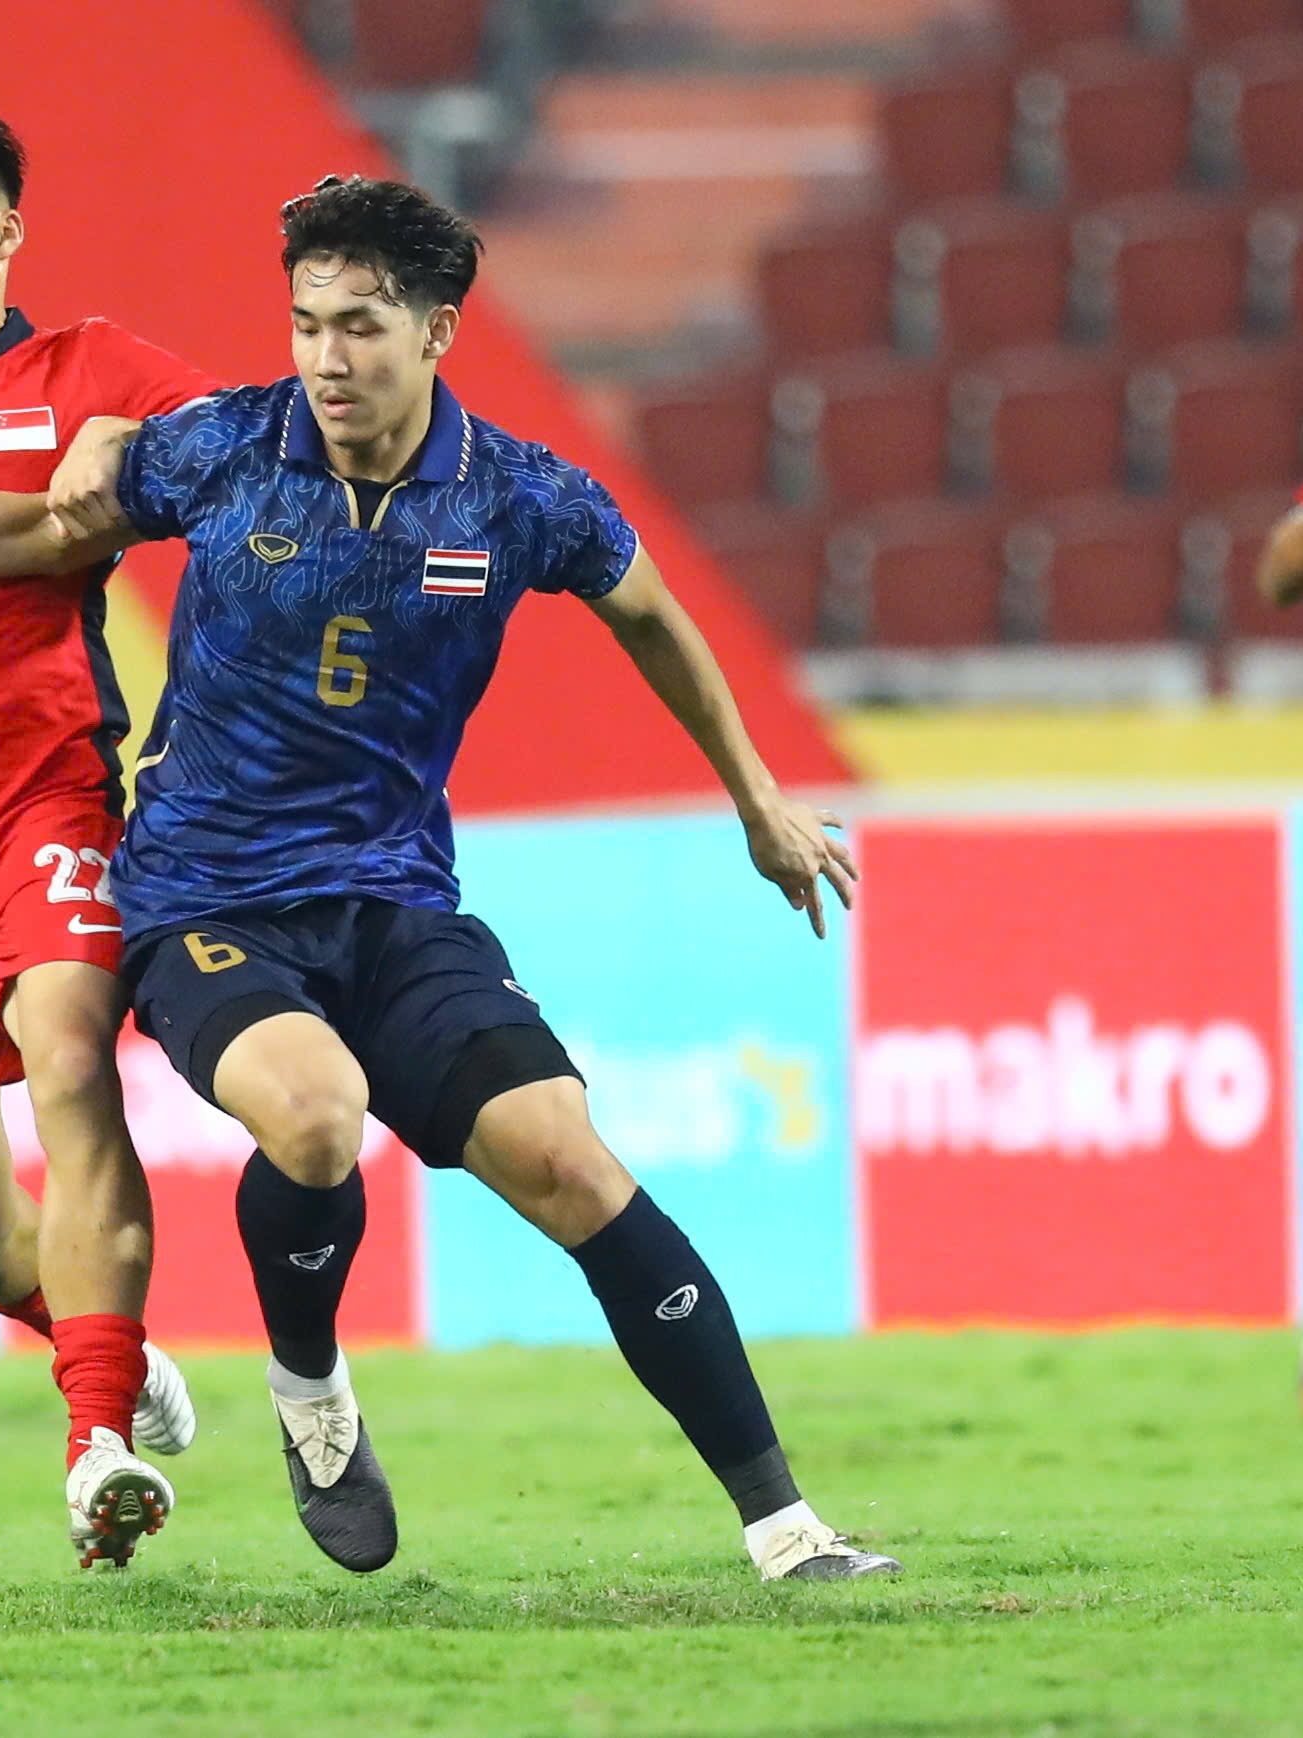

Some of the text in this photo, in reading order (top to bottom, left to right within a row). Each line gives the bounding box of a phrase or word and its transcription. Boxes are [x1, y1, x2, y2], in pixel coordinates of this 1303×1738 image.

[316, 614, 373, 708] 6
[33, 843, 116, 908] 22
[183, 931, 248, 974] 6
[858, 994, 1272, 1156] makro
